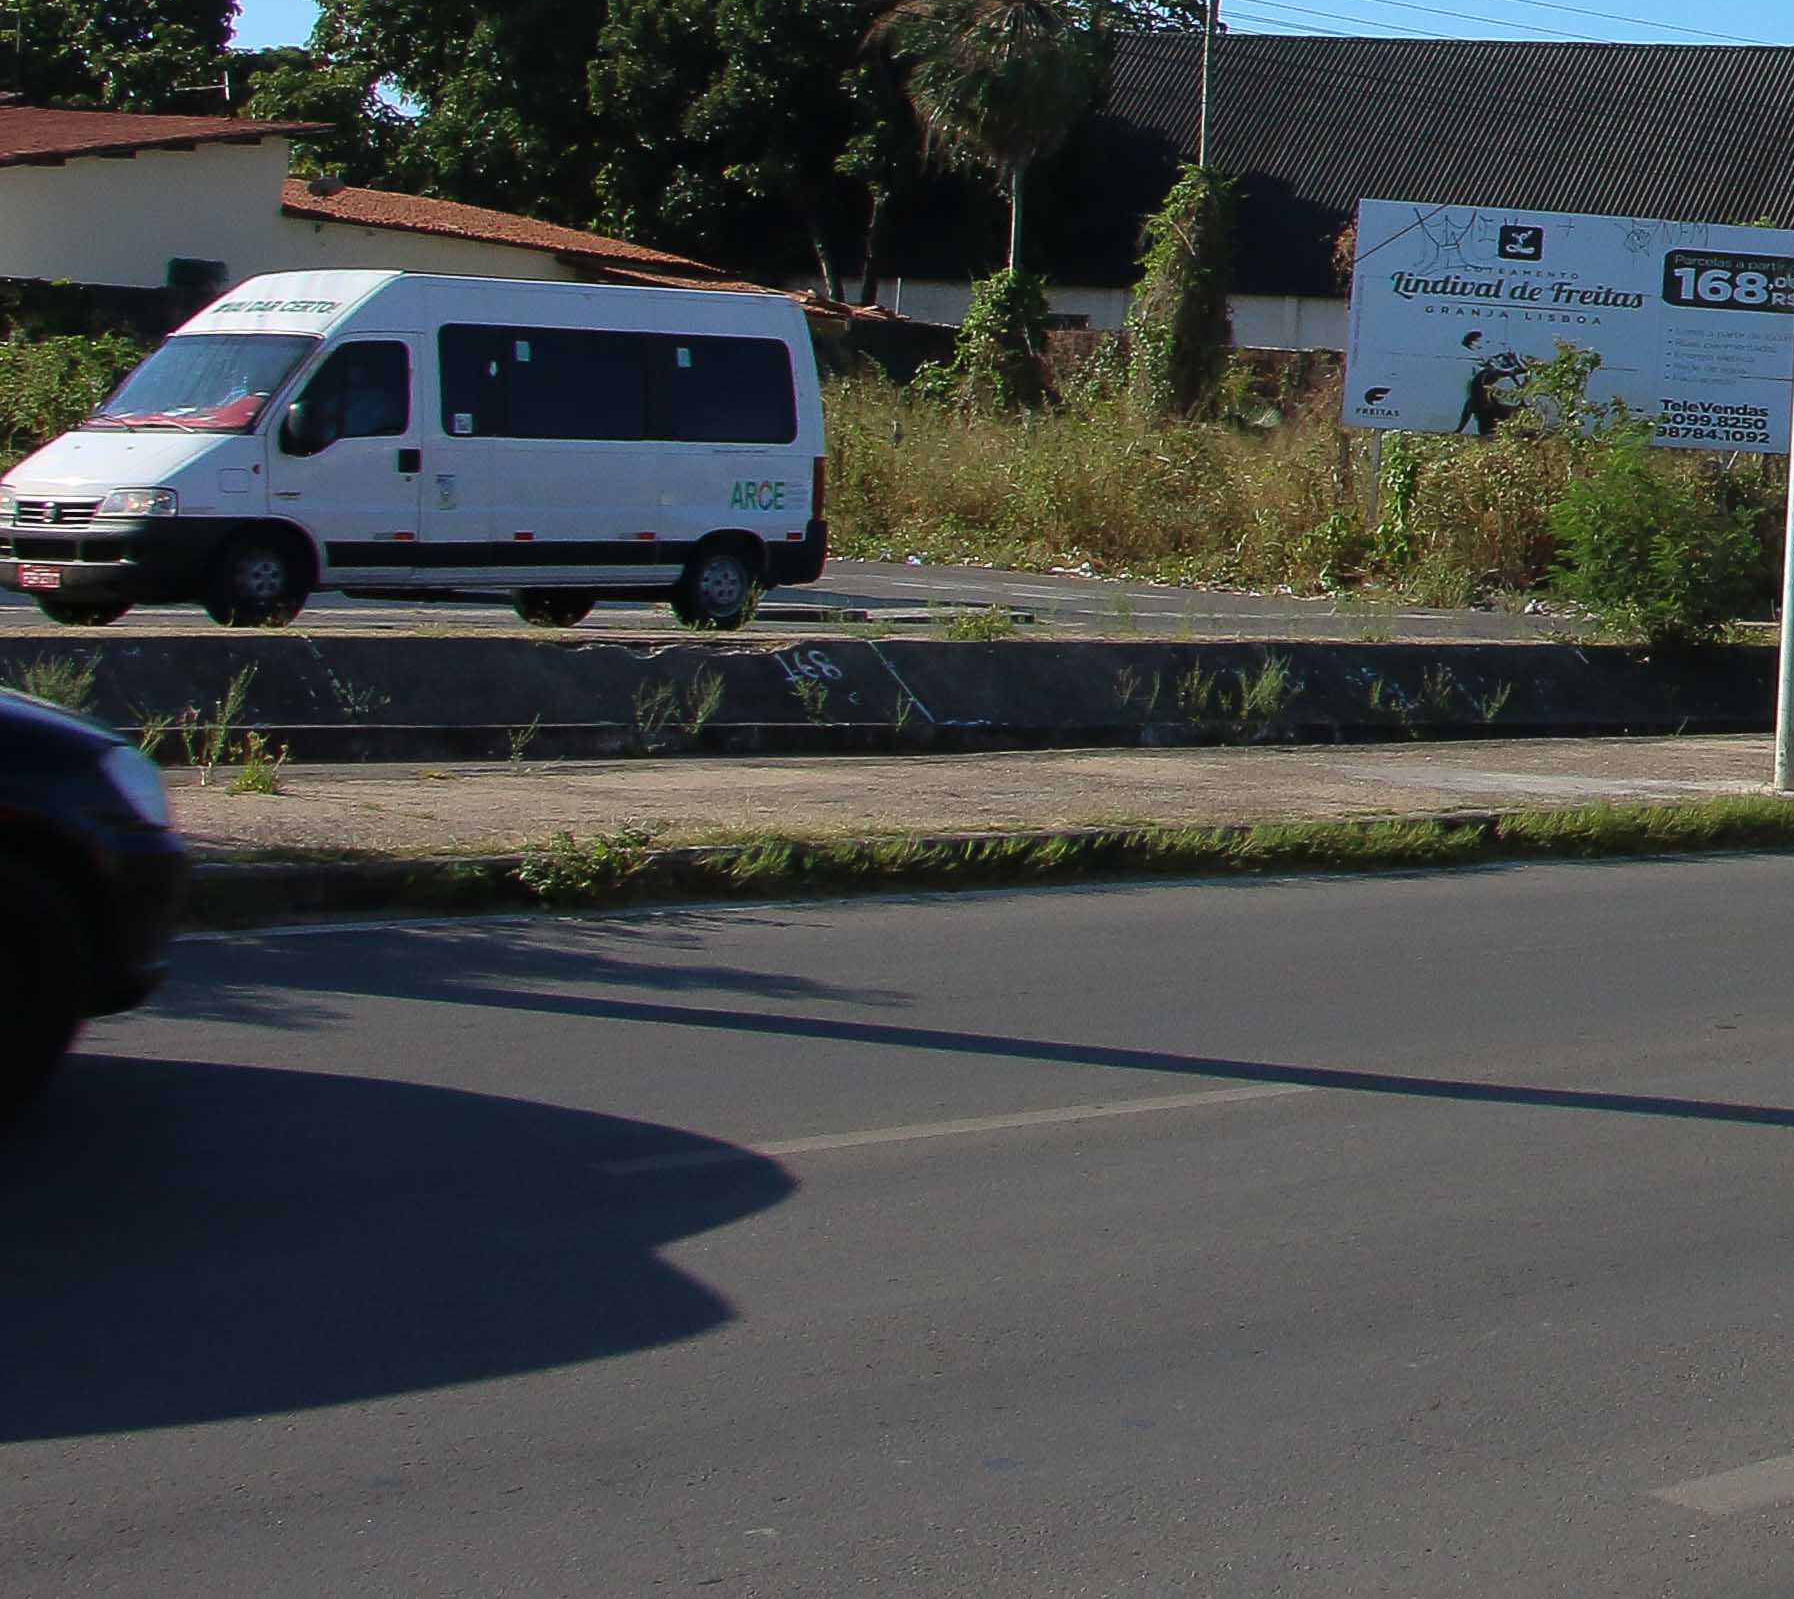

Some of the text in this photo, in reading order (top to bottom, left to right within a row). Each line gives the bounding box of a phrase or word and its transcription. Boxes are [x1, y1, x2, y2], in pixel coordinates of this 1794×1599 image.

[1675, 254, 1732, 269] Parcelas
[1390, 271, 1644, 310] Lindival de Freitas
[1425, 306, 1602, 325] GRANJA LISBOA
[1355, 408, 1401, 418] FREITAS
[1660, 399, 1769, 418] TeleVendas
[730, 481, 785, 511] ARCE
